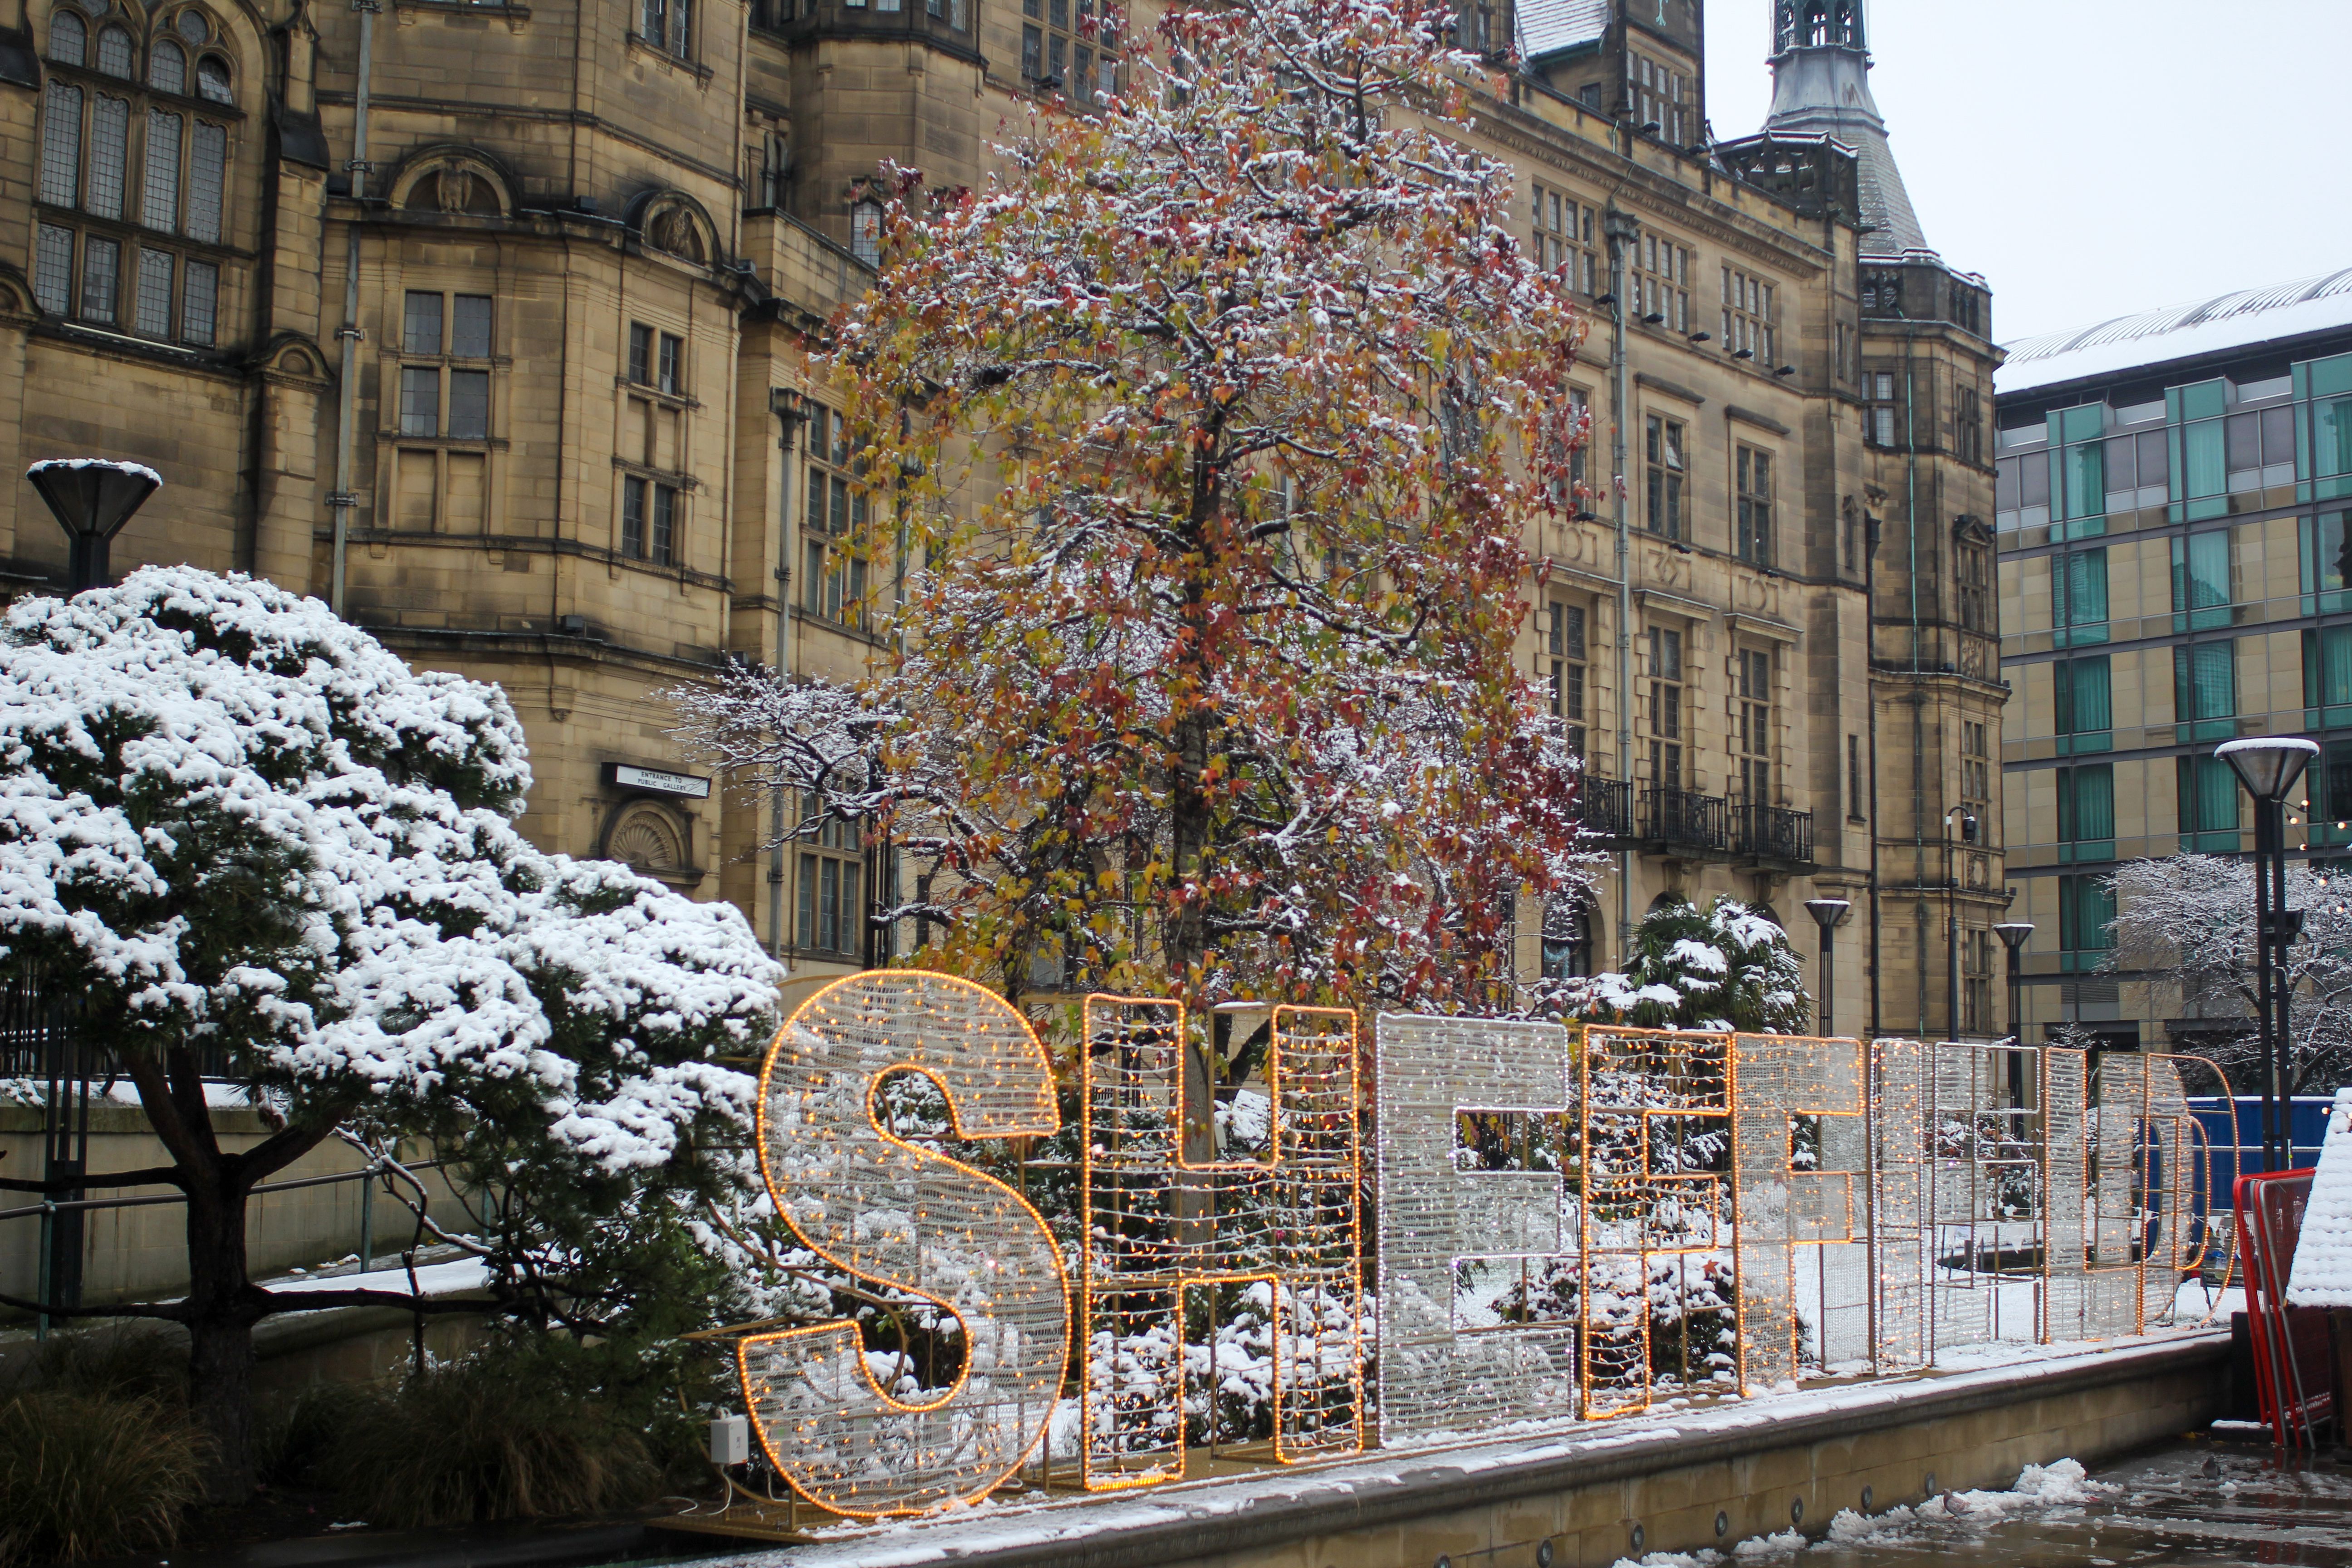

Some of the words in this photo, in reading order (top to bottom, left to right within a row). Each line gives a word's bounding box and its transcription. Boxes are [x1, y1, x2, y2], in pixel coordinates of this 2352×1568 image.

[642, 772, 671, 781] ENTRANCE
[663, 783, 686, 791] GALLERY
[739, 968, 2241, 1519] SHEFFIELD
